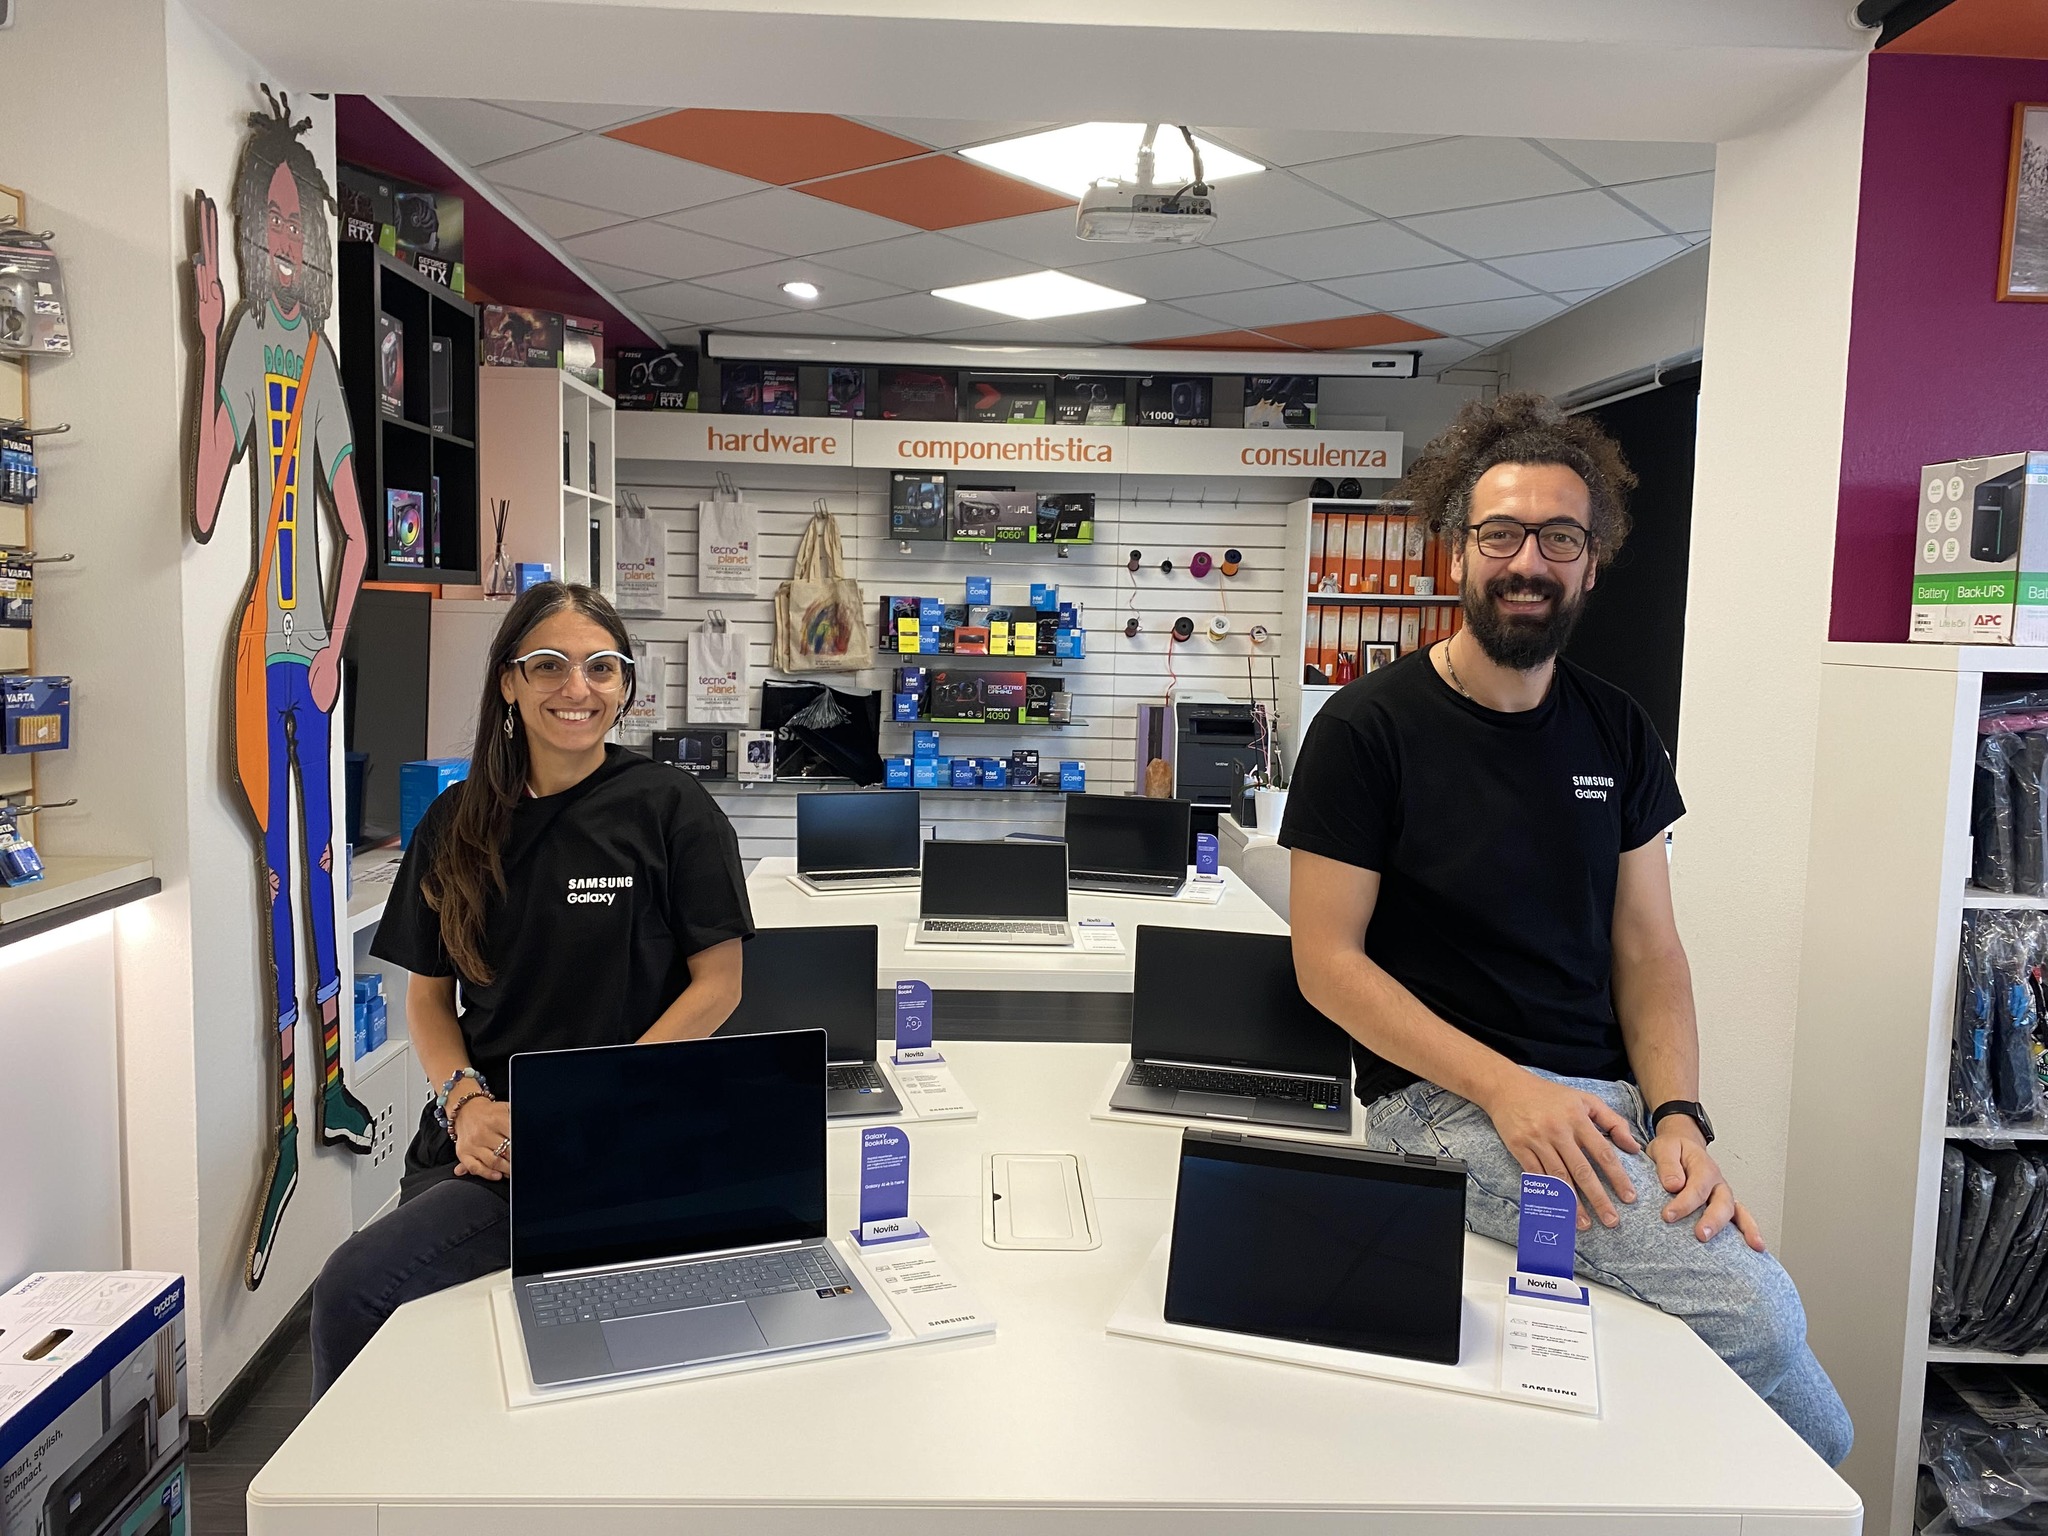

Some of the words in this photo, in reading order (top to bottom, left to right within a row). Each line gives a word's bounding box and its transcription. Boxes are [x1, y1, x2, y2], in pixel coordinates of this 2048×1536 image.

[348, 225, 375, 243] RTX
[418, 264, 447, 285] RTX
[660, 397, 683, 408] RTX
[1141, 411, 1174, 420] V1000
[707, 426, 836, 455] hardware
[9, 440, 33, 453] VARTA
[898, 436, 1112, 466] componentistica
[1240, 442, 1387, 468] consulenza
[1006, 505, 1033, 514] DUAL
[893, 514, 903, 525] 8
[997, 531, 1020, 540] 4060
[710, 545, 739, 555] tecno
[717, 554, 749, 565] planet
[616, 561, 645, 572] tecno
[7, 568, 32, 579] VARTA
[624, 571, 655, 581] planet
[1918, 587, 1950, 602] Battery
[1957, 585, 2005, 599] Back-UPS
[1974, 615, 2002, 626] APC
[699, 675, 726, 685] tecno
[706, 684, 737, 695] planet
[6, 693, 35, 703] VARTA
[986, 711, 1010, 720] 4090
[1575, 788, 1607, 802] Galaxy
[568, 876, 633, 890] SAMSUNG
[567, 892, 616, 906] Galaxy
[904, 1050, 924, 1058] Novità
[864, 1132, 887, 1141] Galaxy
[864, 1139, 883, 1148] Book4
[883, 1137, 899, 1146] Edge
[1523, 1180, 1549, 1189] Galaxy
[1523, 1186, 1545, 1195] Book4
[1546, 1189, 1559, 1197] 360
[873, 1223, 899, 1235] Novità
[1527, 1278, 1558, 1291] Novità
[153, 1288, 181, 1317] brother
[928, 1315, 976, 1327] SAMSUNG
[1521, 1383, 1577, 1397] SAMSUNG
[3, 1456, 32, 1489] Smart,
[33, 1428, 63, 1462] stylish,
[4, 1462, 42, 1504] compact
